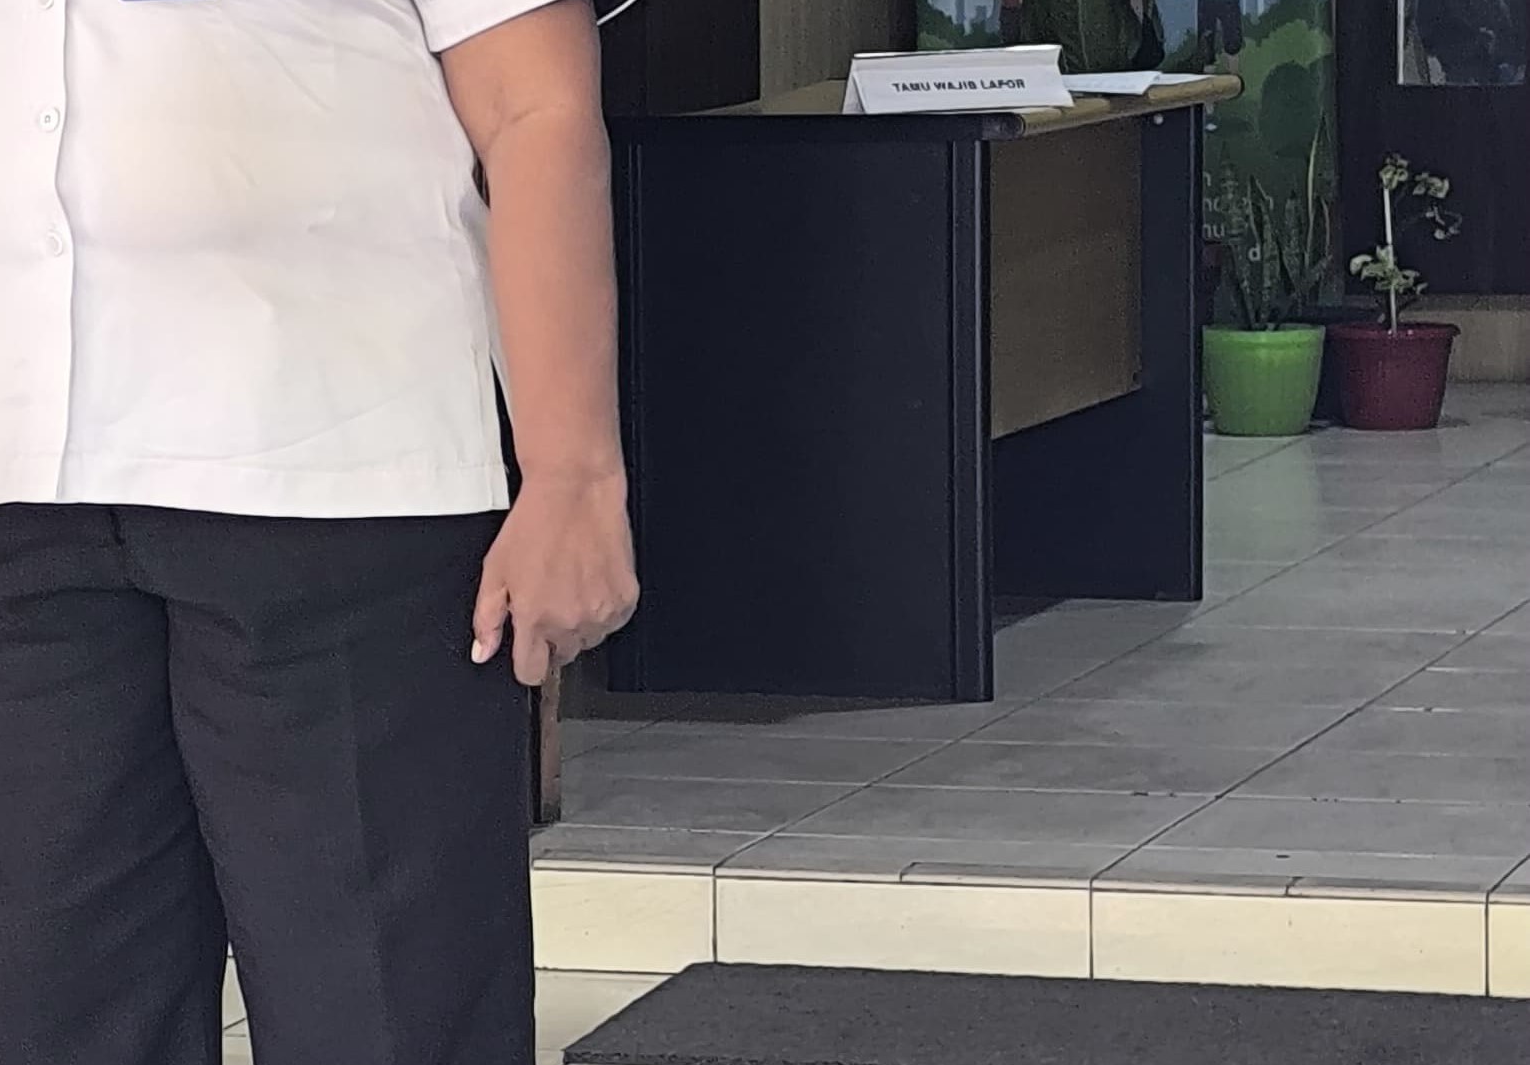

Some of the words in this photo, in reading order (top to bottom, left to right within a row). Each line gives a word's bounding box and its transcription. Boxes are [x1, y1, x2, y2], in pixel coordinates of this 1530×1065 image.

[891, 81, 931, 93] TAMU
[933, 80, 978, 91] WAJIB
[980, 78, 1026, 90] LAPOR
